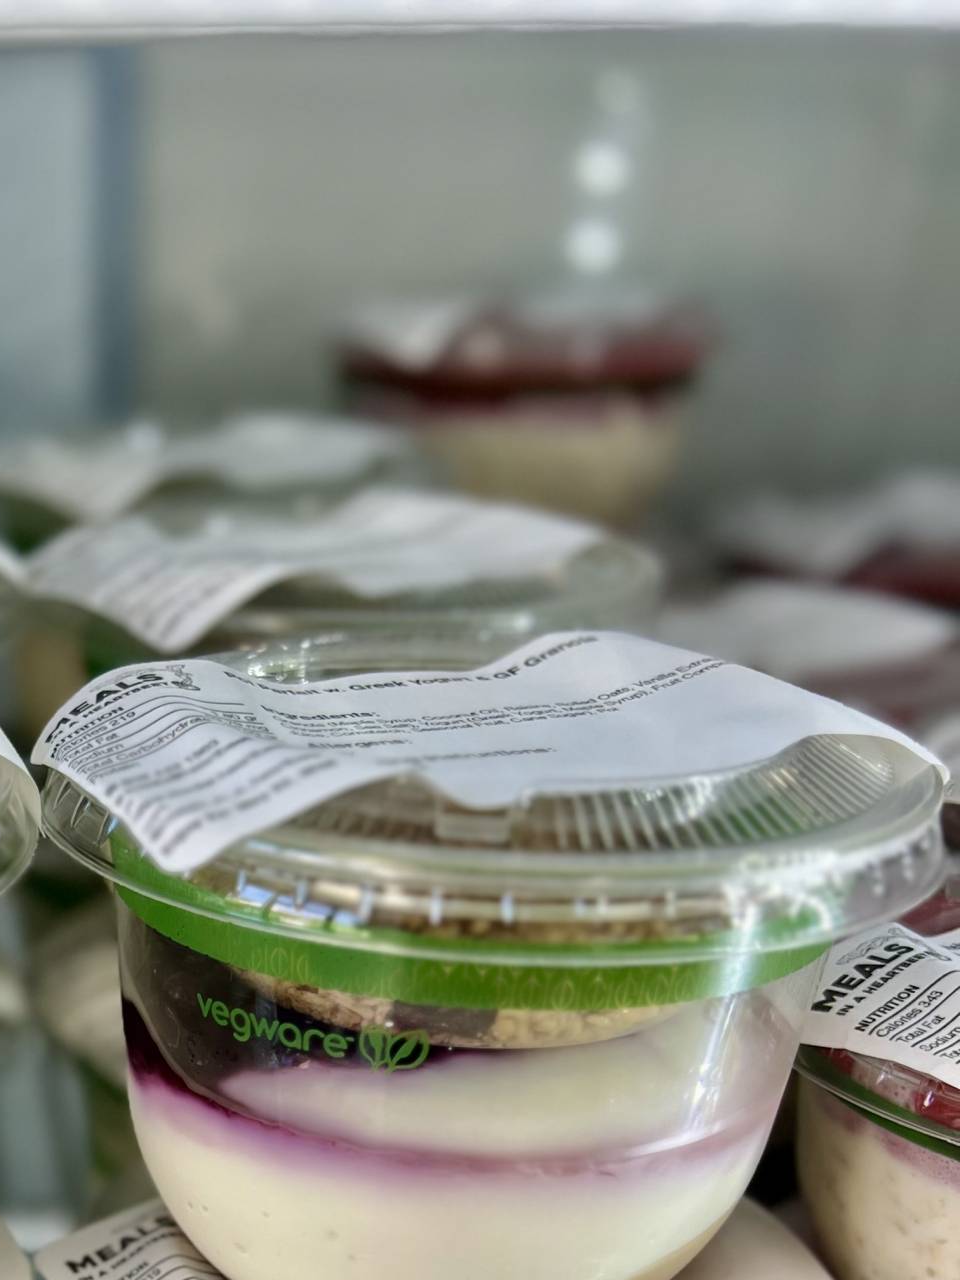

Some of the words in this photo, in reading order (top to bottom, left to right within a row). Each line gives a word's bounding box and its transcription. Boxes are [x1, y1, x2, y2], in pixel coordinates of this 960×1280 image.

[349, 679, 408, 691] Greek
[493, 665, 521, 681] GF
[524, 635, 598, 669] Granola
[45, 673, 165, 743] MEALS
[811, 944, 915, 1013] MEALS
[197, 992, 349, 1058] vegware
[836, 1004, 855, 1016] IN
[854, 995, 867, 1005] A
[855, 984, 921, 1032] NUTRITION
[876, 1006, 922, 1037] Calories
[918, 989, 944, 1009] 343
[895, 1026, 927, 1044] Total
[924, 1015, 946, 1030] Fat
